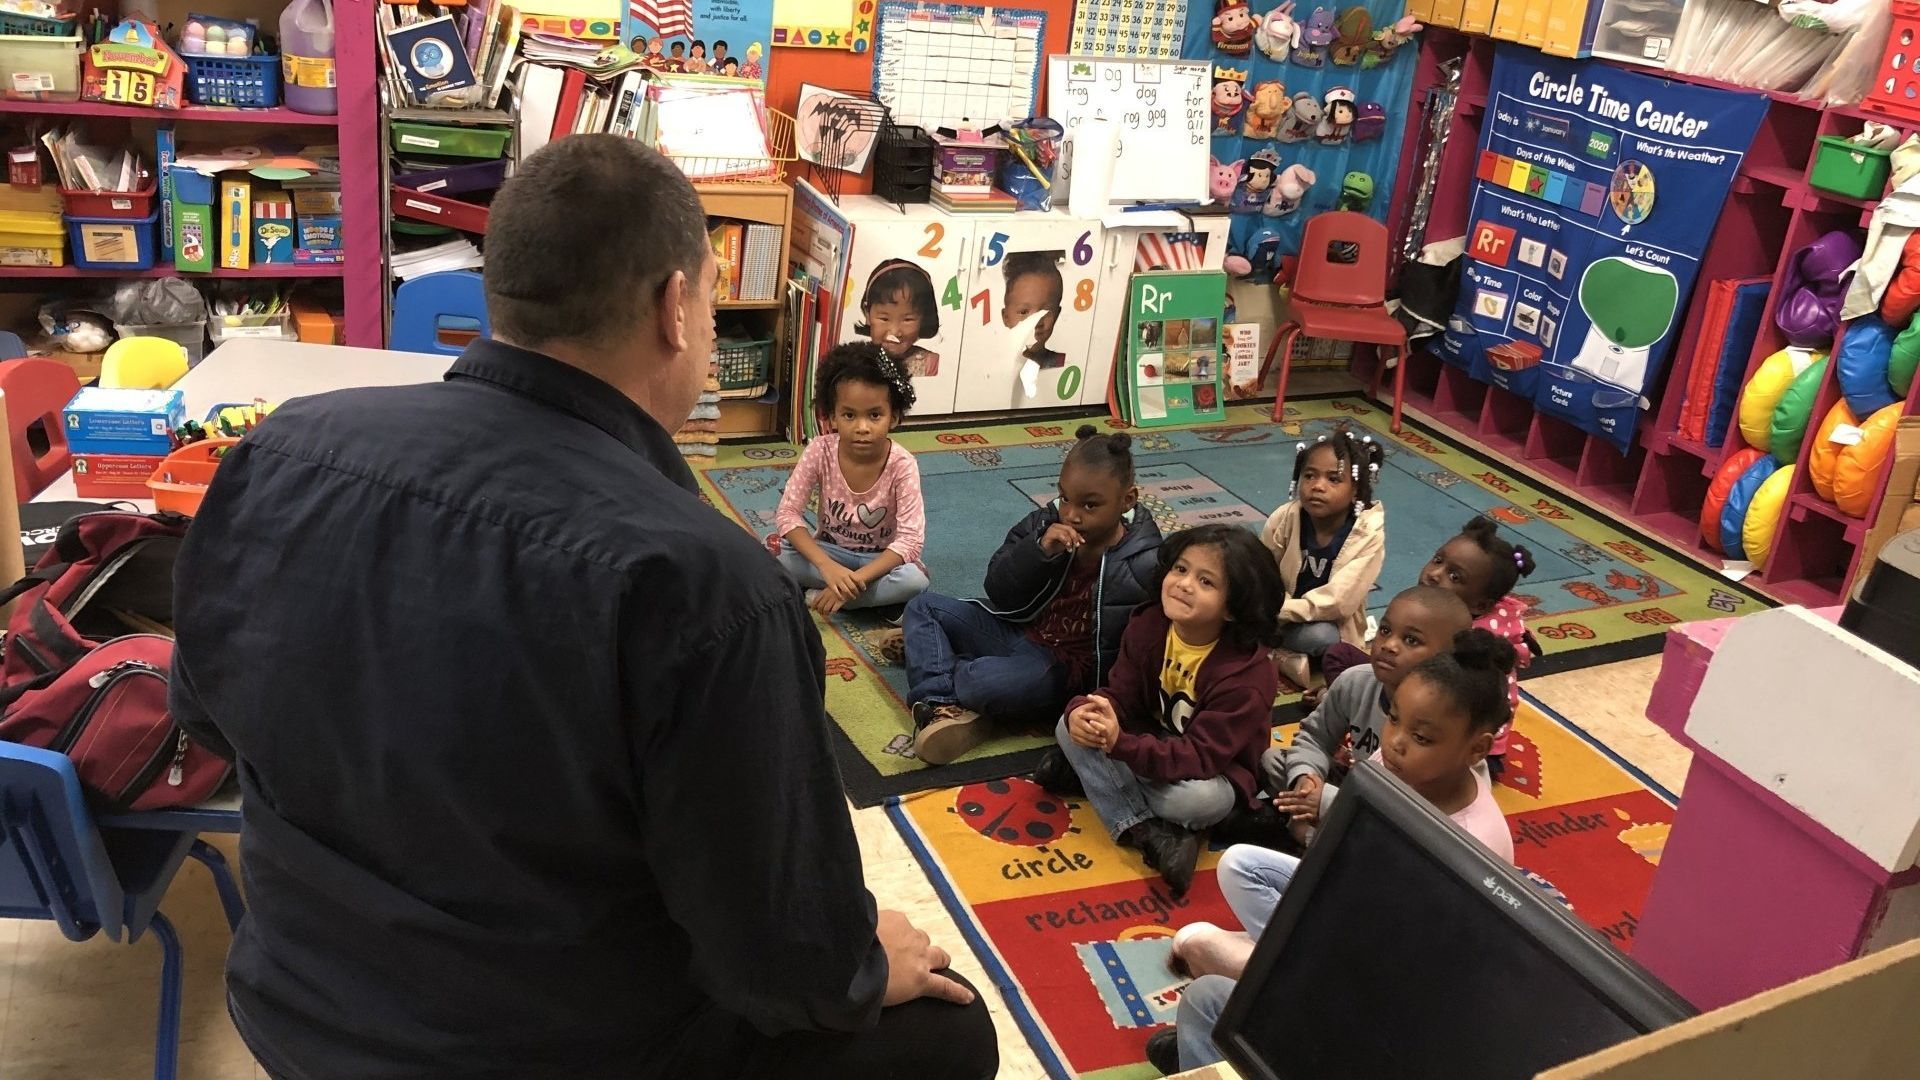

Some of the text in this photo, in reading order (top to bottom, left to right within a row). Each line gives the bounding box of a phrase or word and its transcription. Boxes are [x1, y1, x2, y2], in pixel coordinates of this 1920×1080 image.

[723, 5, 740, 14] liberty
[1124, 0, 1132, 8] 25
[1134, 1, 1143, 9] 26
[1145, 2, 1154, 10] 27
[1156, 3, 1165, 11] 28
[1167, 4, 1176, 12] 29
[1177, 4, 1186, 13] 30
[1078, 11, 1085, 19] 31
[1088, 12, 1097, 20] 32
[1111, 14, 1119, 22] 34
[1121, 15, 1130, 23] 35
[1132, 16, 1141, 24] 36
[1143, 17, 1152, 25] 37
[1154, 18, 1163, 26] 38
[1164, 19, 1173, 27] 39
[1076, 26, 1083, 34] 41
[1086, 28, 1095, 36] 42
[1097, 28, 1106, 37] 43
[1119, 30, 1128, 38] 45
[1130, 31, 1139, 39] 46
[1141, 32, 1150, 40] 47
[1152, 32, 1160, 40] 48
[1162, 33, 1171, 41] 49
[1172, 34, 1181, 43] 50
[1074, 41, 1081, 49] 51
[1084, 43, 1093, 51] 52
[1106, 44, 1115, 52] 54
[1117, 45, 1125, 53] 55
[1127, 46, 1136, 54] 56
[1139, 46, 1147, 55] 57
[1149, 47, 1158, 55] 58
[1160, 48, 1168, 56] 59
[1170, 48, 1179, 57] 60
[1217, 42, 1249, 50] fireman
[1104, 68, 1122, 92] og
[1192, 77, 1202, 91] if
[111, 79, 148, 102] 1 5
[1065, 81, 1157, 107] frog dog
[1184, 91, 1204, 106] for
[1186, 108, 1204, 119] are
[1529, 71, 1709, 139] Circle Time Center
[1147, 108, 1167, 128] gog
[1187, 120, 1203, 130] all
[1512, 116, 1519, 126] is
[1191, 132, 1204, 145] be
[1541, 124, 1567, 138] January
[1588, 138, 1610, 152] 2020
[1636, 140, 1726, 166] What's the Weather?
[1516, 147, 1533, 160] Days
[1533, 152, 1543, 161] of
[1543, 154, 1556, 165] the
[1557, 157, 1576, 173] Week
[1501, 204, 1525, 220] What's
[1526, 212, 1538, 224] the
[917, 222, 945, 258] 2
[985, 231, 1011, 267] 5
[1072, 230, 1093, 266] 6
[1477, 228, 1506, 255] Rr
[1625, 244, 1671, 265] Let's Count
[1483, 276, 1503, 289] Time
[941, 275, 963, 311] 4
[1073, 278, 1095, 312] 8
[1141, 283, 1172, 314] Rr
[1523, 288, 1543, 302] Color
[970, 288, 991, 326] 7
[1056, 365, 1081, 400] 0
[1551, 384, 1573, 399] Picture
[1551, 394, 1569, 407] Cards
[1023, 426, 1064, 437] Rr
[1160, 484, 1194, 492] Nine
[1472, 471, 1520, 494] Xx
[1179, 496, 1217, 506] Eight
[828, 497, 854, 527] My
[1198, 510, 1244, 520] Seven
[880, 527, 892, 538] to
[1707, 588, 1746, 613] Aa
[1624, 607, 1682, 626] Bb
[1537, 622, 1598, 640] Cc
[1001, 848, 1094, 881] circle
[1025, 880, 1191, 933] rectangle
